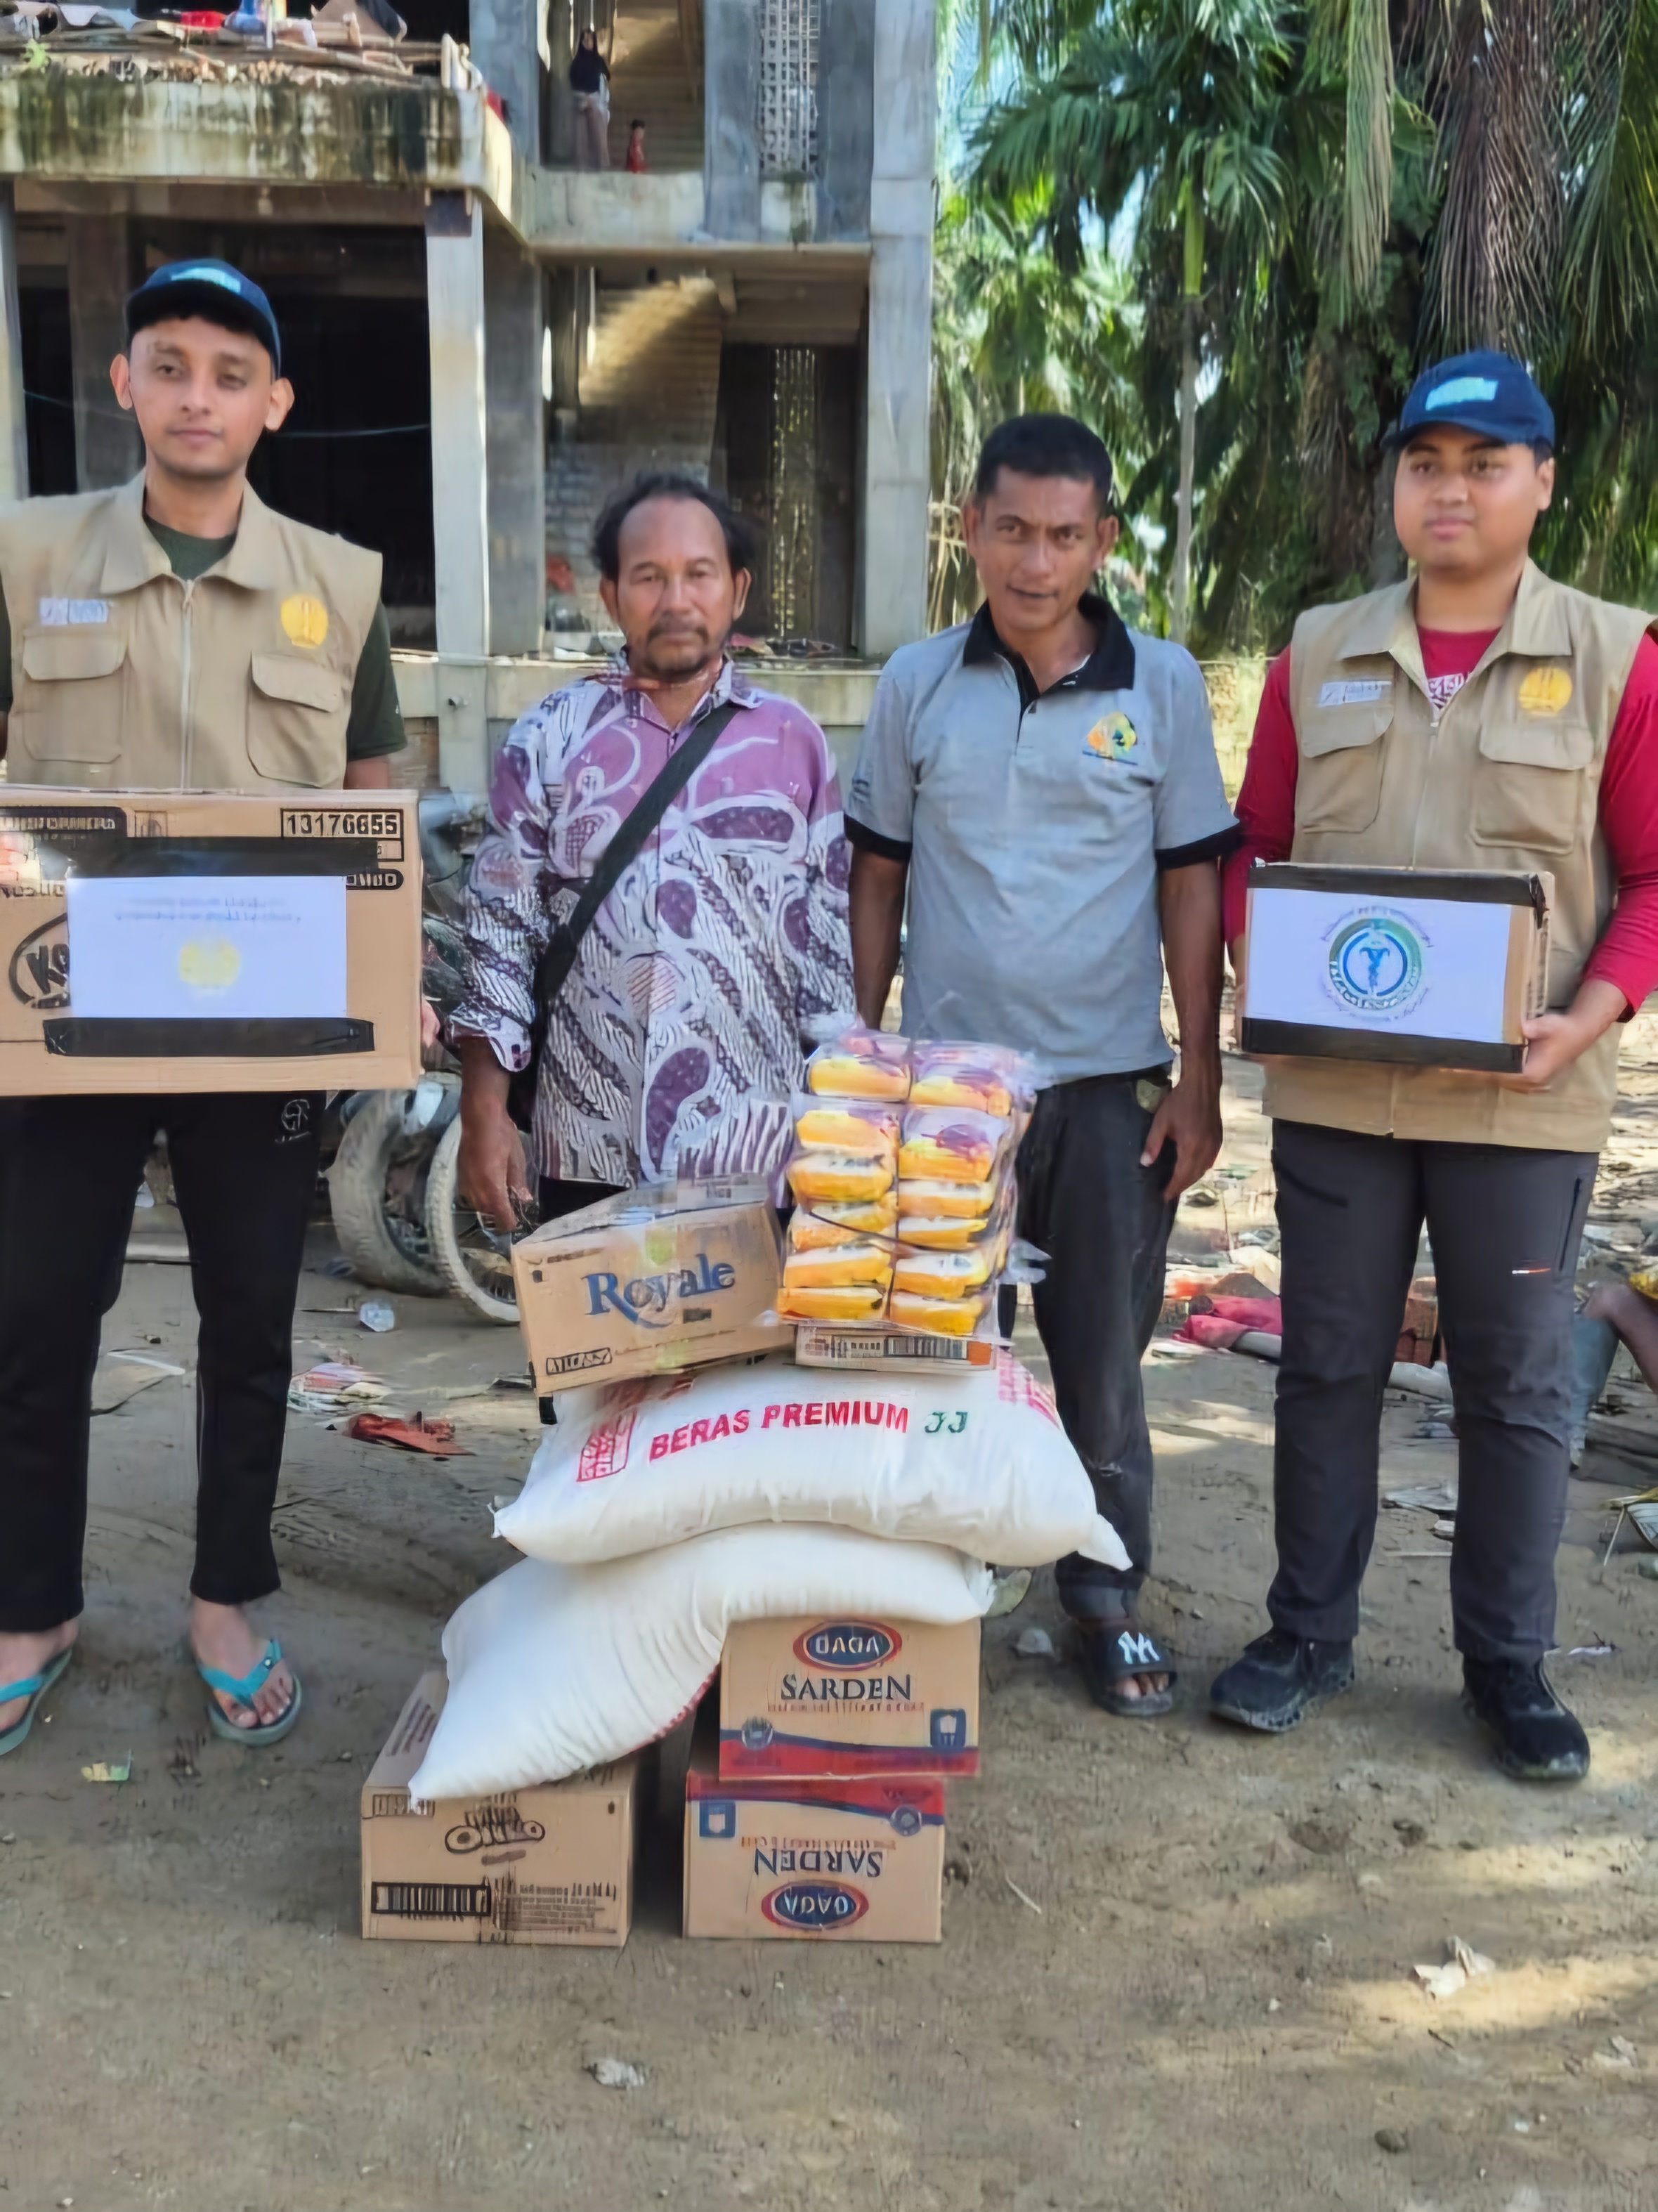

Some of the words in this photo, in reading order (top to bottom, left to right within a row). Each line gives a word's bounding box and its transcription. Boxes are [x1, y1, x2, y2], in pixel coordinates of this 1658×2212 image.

[582, 1253, 736, 1329] Royale
[648, 1410, 750, 1462] BERAS
[761, 1401, 908, 1433] PREMIUM
[925, 1411, 968, 1433] JJ
[781, 1674, 911, 1700] SARDEN
[754, 1848, 884, 1878] SARDEN
